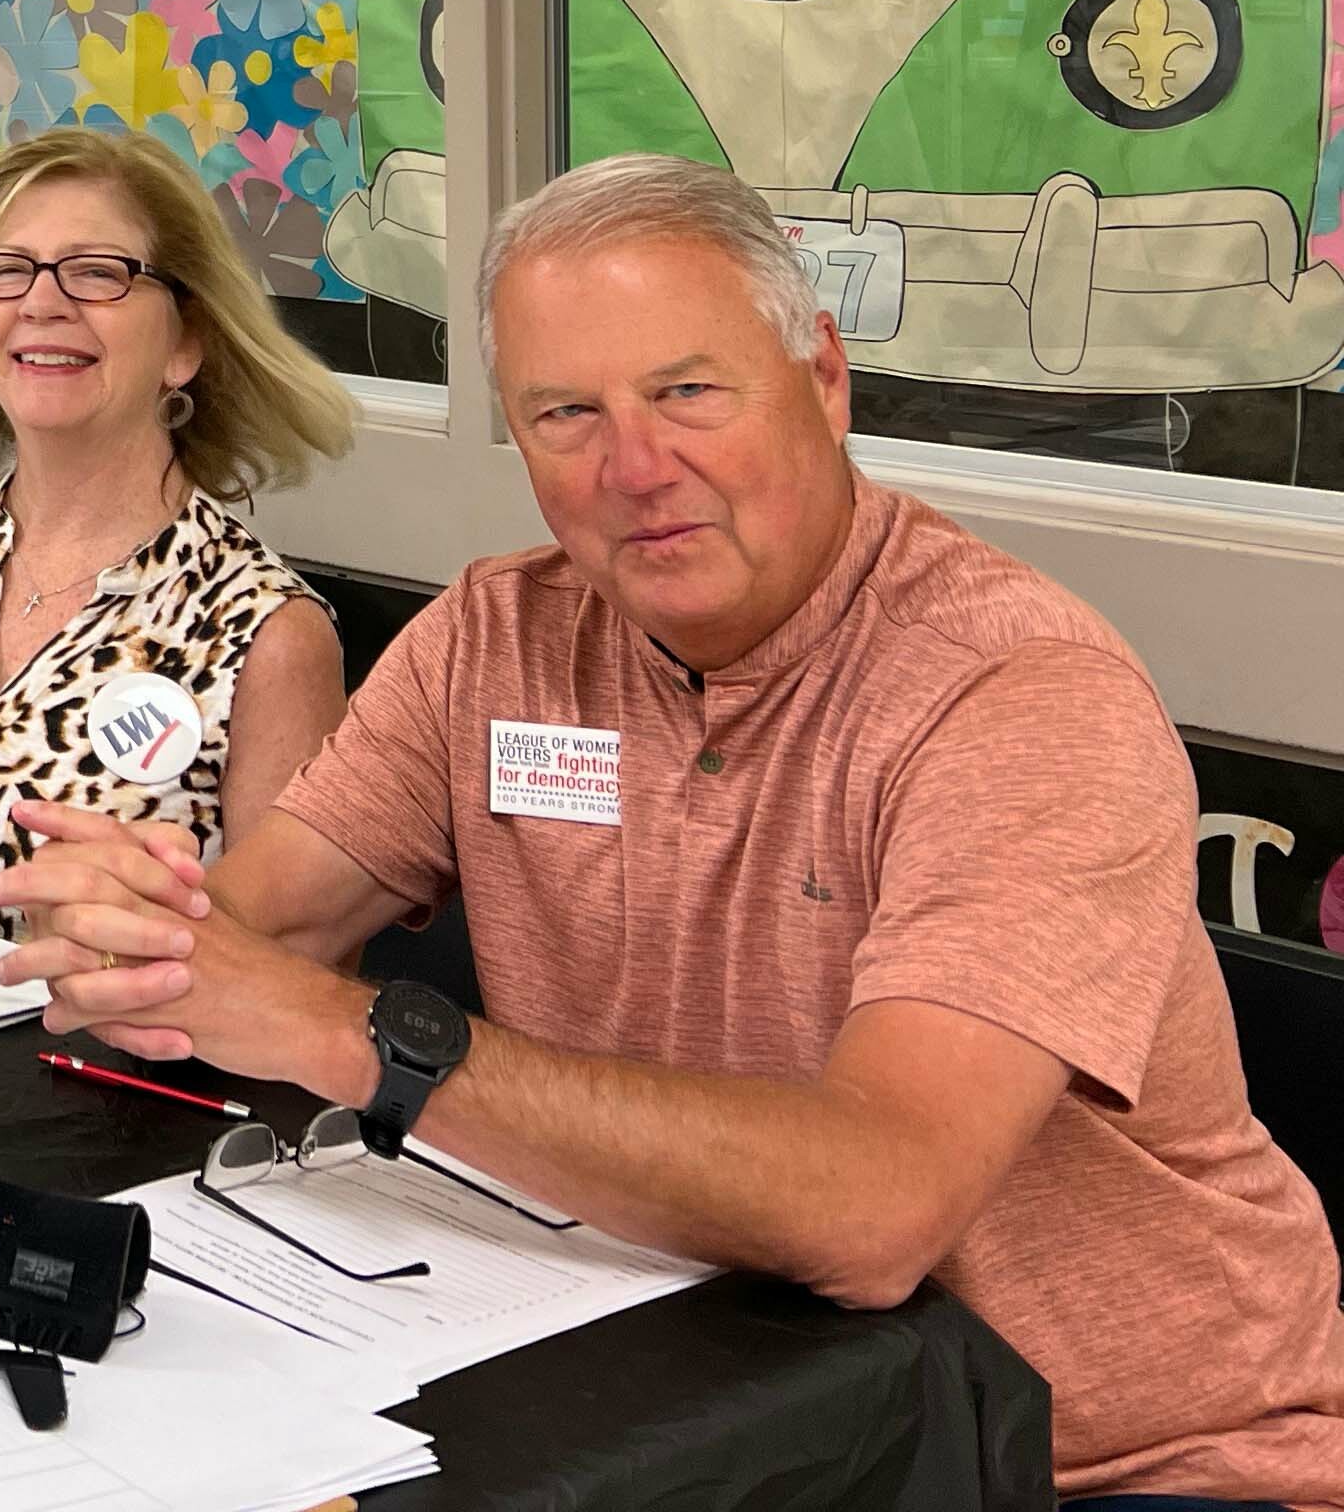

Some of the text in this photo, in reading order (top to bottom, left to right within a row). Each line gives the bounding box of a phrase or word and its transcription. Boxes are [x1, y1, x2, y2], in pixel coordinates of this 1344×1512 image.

[497, 731, 547, 749] LEAGUE
[551, 737, 569, 751] OF
[497, 745, 552, 762] VOTERS
[497, 766, 521, 783] for
[496, 793, 517, 804] 100
[523, 796, 565, 809] YEARS
